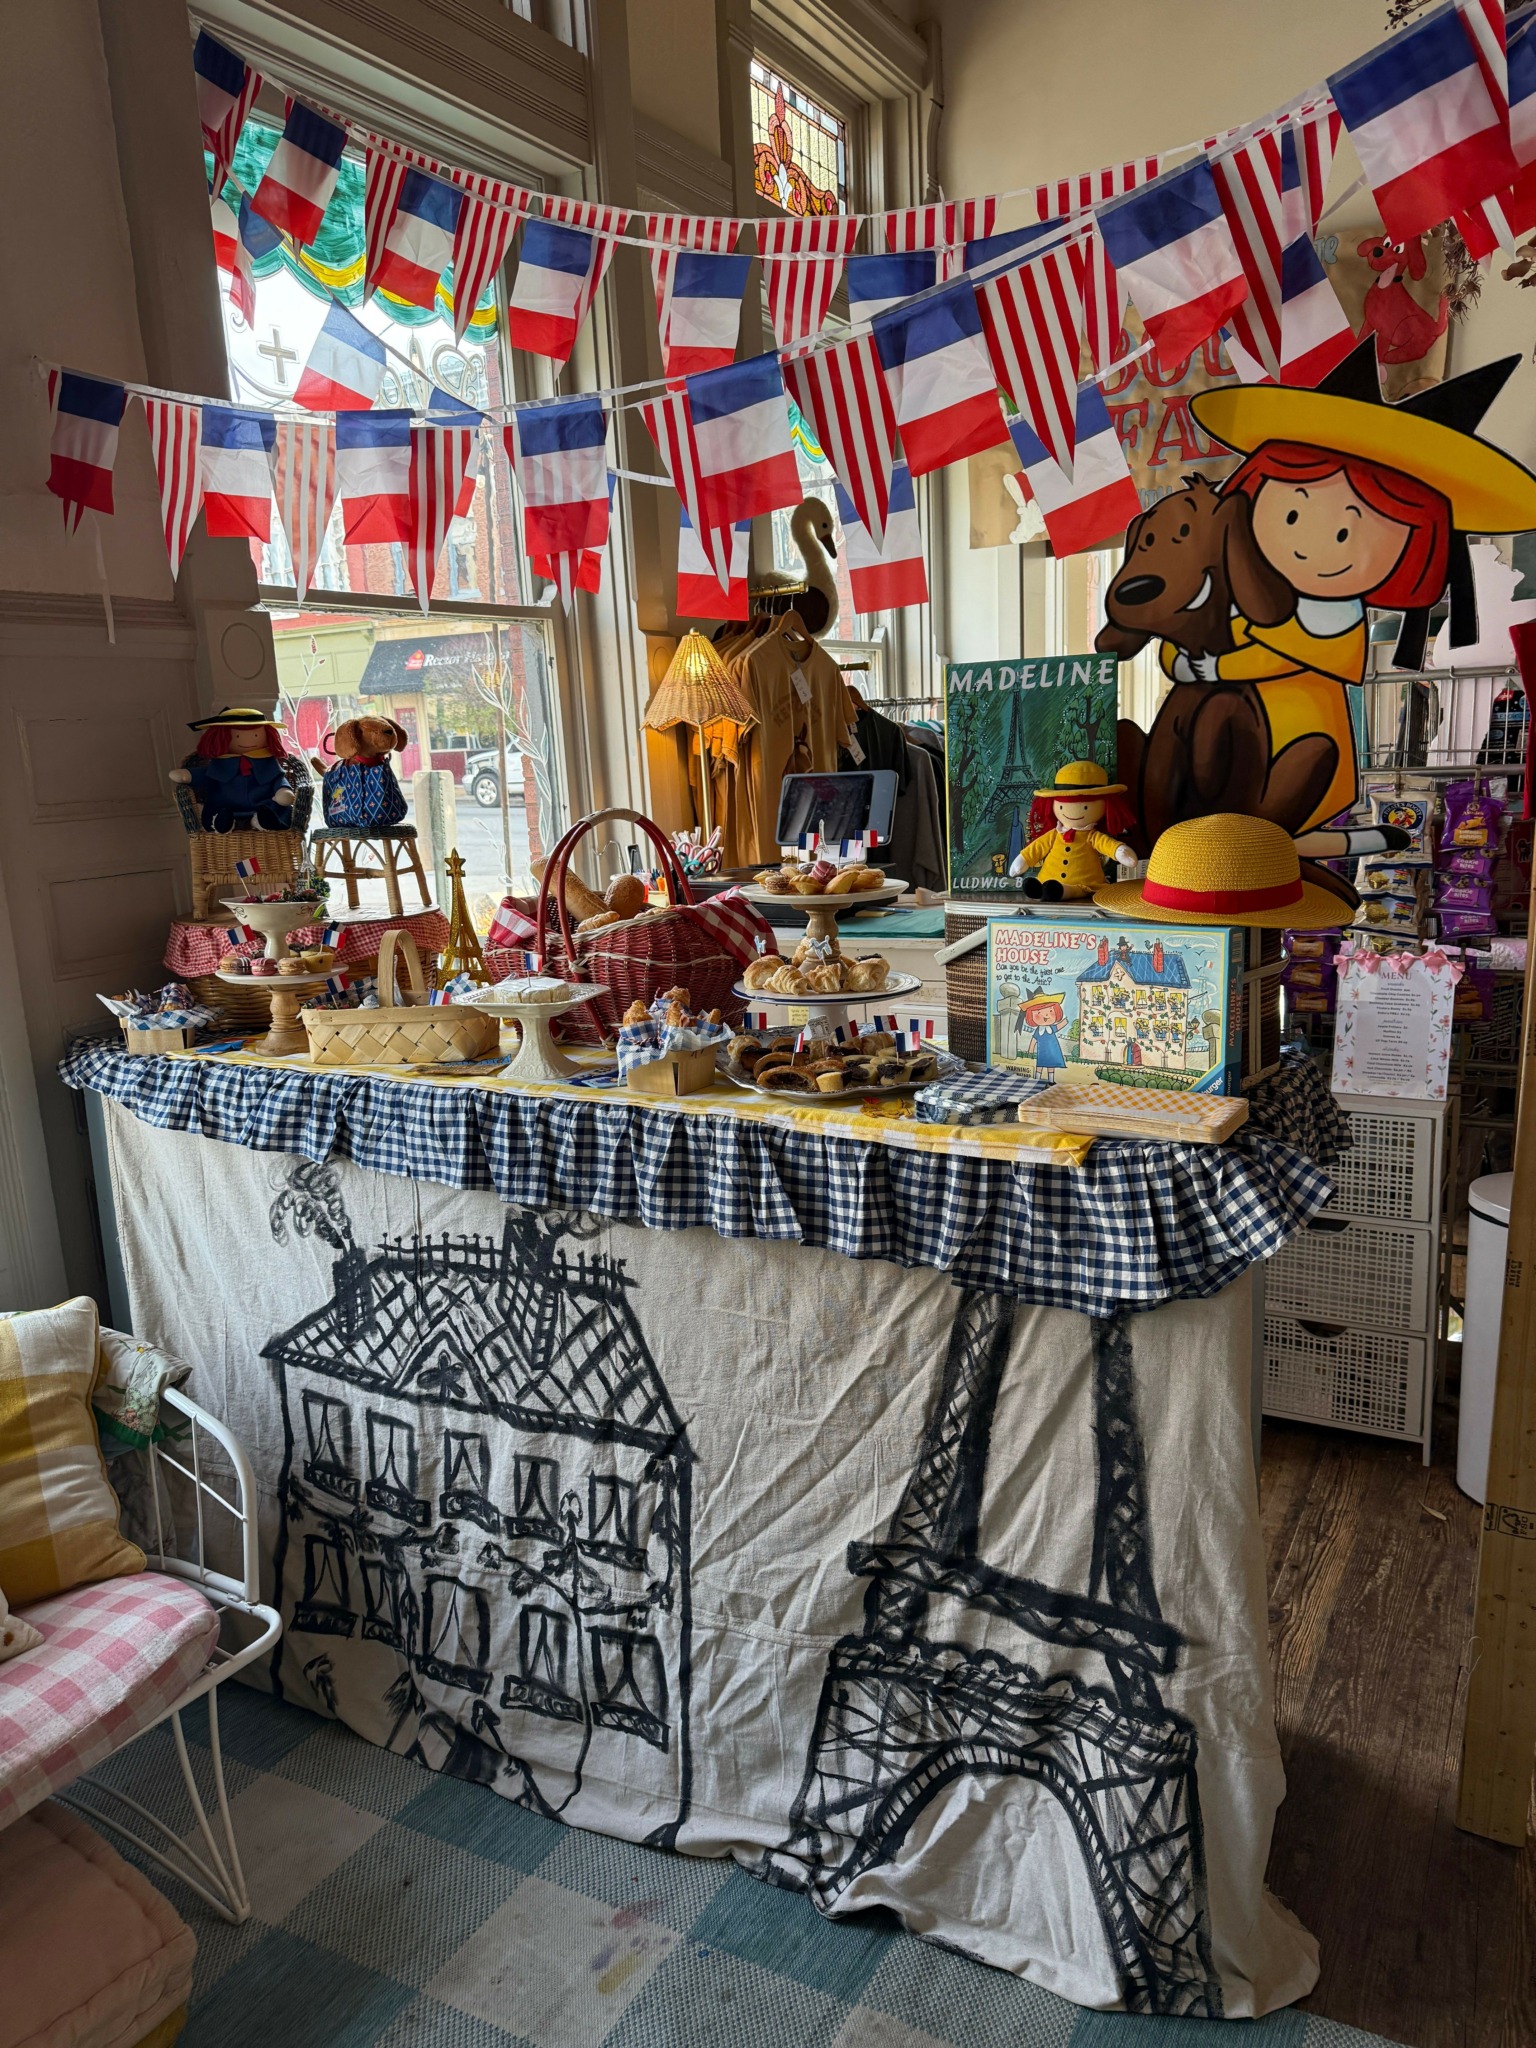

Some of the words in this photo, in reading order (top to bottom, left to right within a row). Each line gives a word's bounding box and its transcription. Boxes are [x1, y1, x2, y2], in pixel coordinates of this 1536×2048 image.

[949, 659, 1115, 694] MADELINE
[953, 877, 1008, 889] LUDWIG
[995, 929, 1097, 950] MADELINE'S
[995, 947, 1049, 965] HOUSE
[996, 963, 1008, 971] Can
[1009, 964, 1019, 973] you
[1030, 966, 1038, 975] the
[1040, 967, 1053, 978] first
[1381, 971, 1412, 980] MENU
[1004, 974, 1013, 983] get
[1022, 974, 1031, 983] the
[1031, 977, 1053, 986] Attic?
[1228, 977, 1237, 1047] MADELINE'S
[1005, 1065, 1032, 1074] WARNING:
